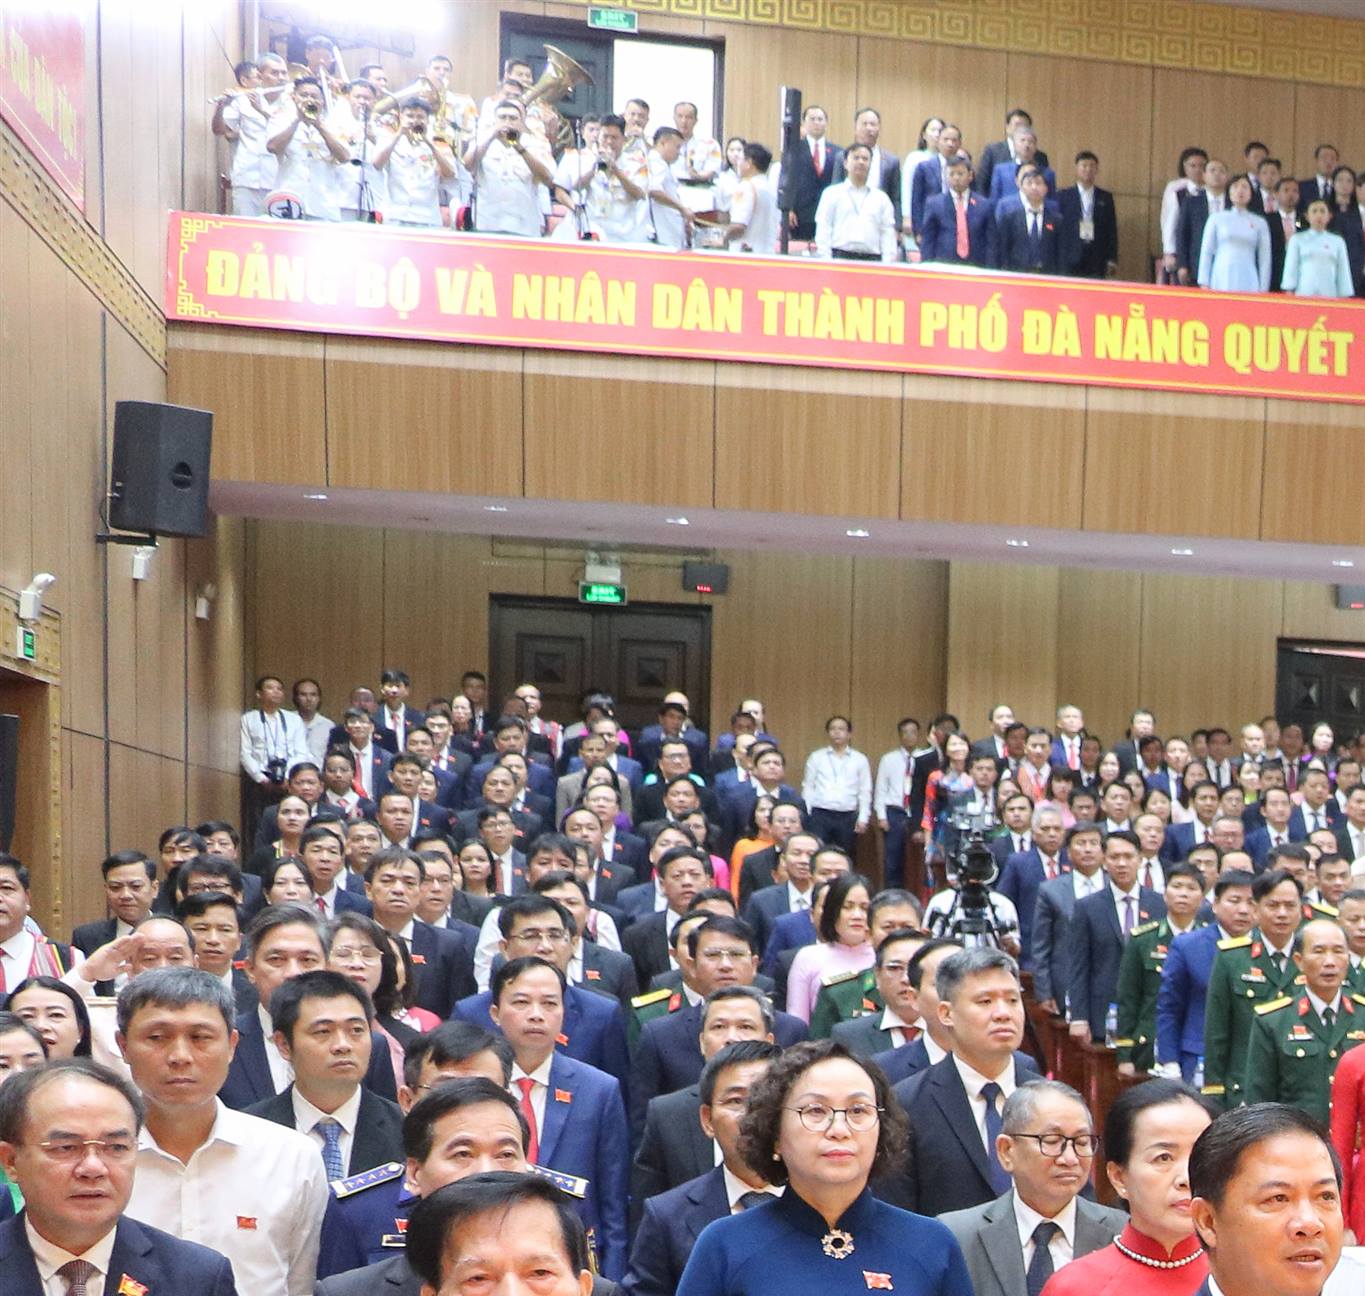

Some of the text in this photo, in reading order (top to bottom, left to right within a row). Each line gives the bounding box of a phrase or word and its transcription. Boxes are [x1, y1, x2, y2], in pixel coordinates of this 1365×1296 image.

[354, 256, 422, 320] BỘ
[435, 262, 498, 318] VÀ
[512, 270, 636, 327] NHÂN
[652, 277, 743, 334] DÂN
[757, 286, 905, 344] THÀNH
[920, 292, 1008, 353] PHỐ
[1021, 304, 1081, 358] ĐÀ
[1095, 303, 1210, 367] NẴNG
[1224, 315, 1354, 377] QUYẾT
